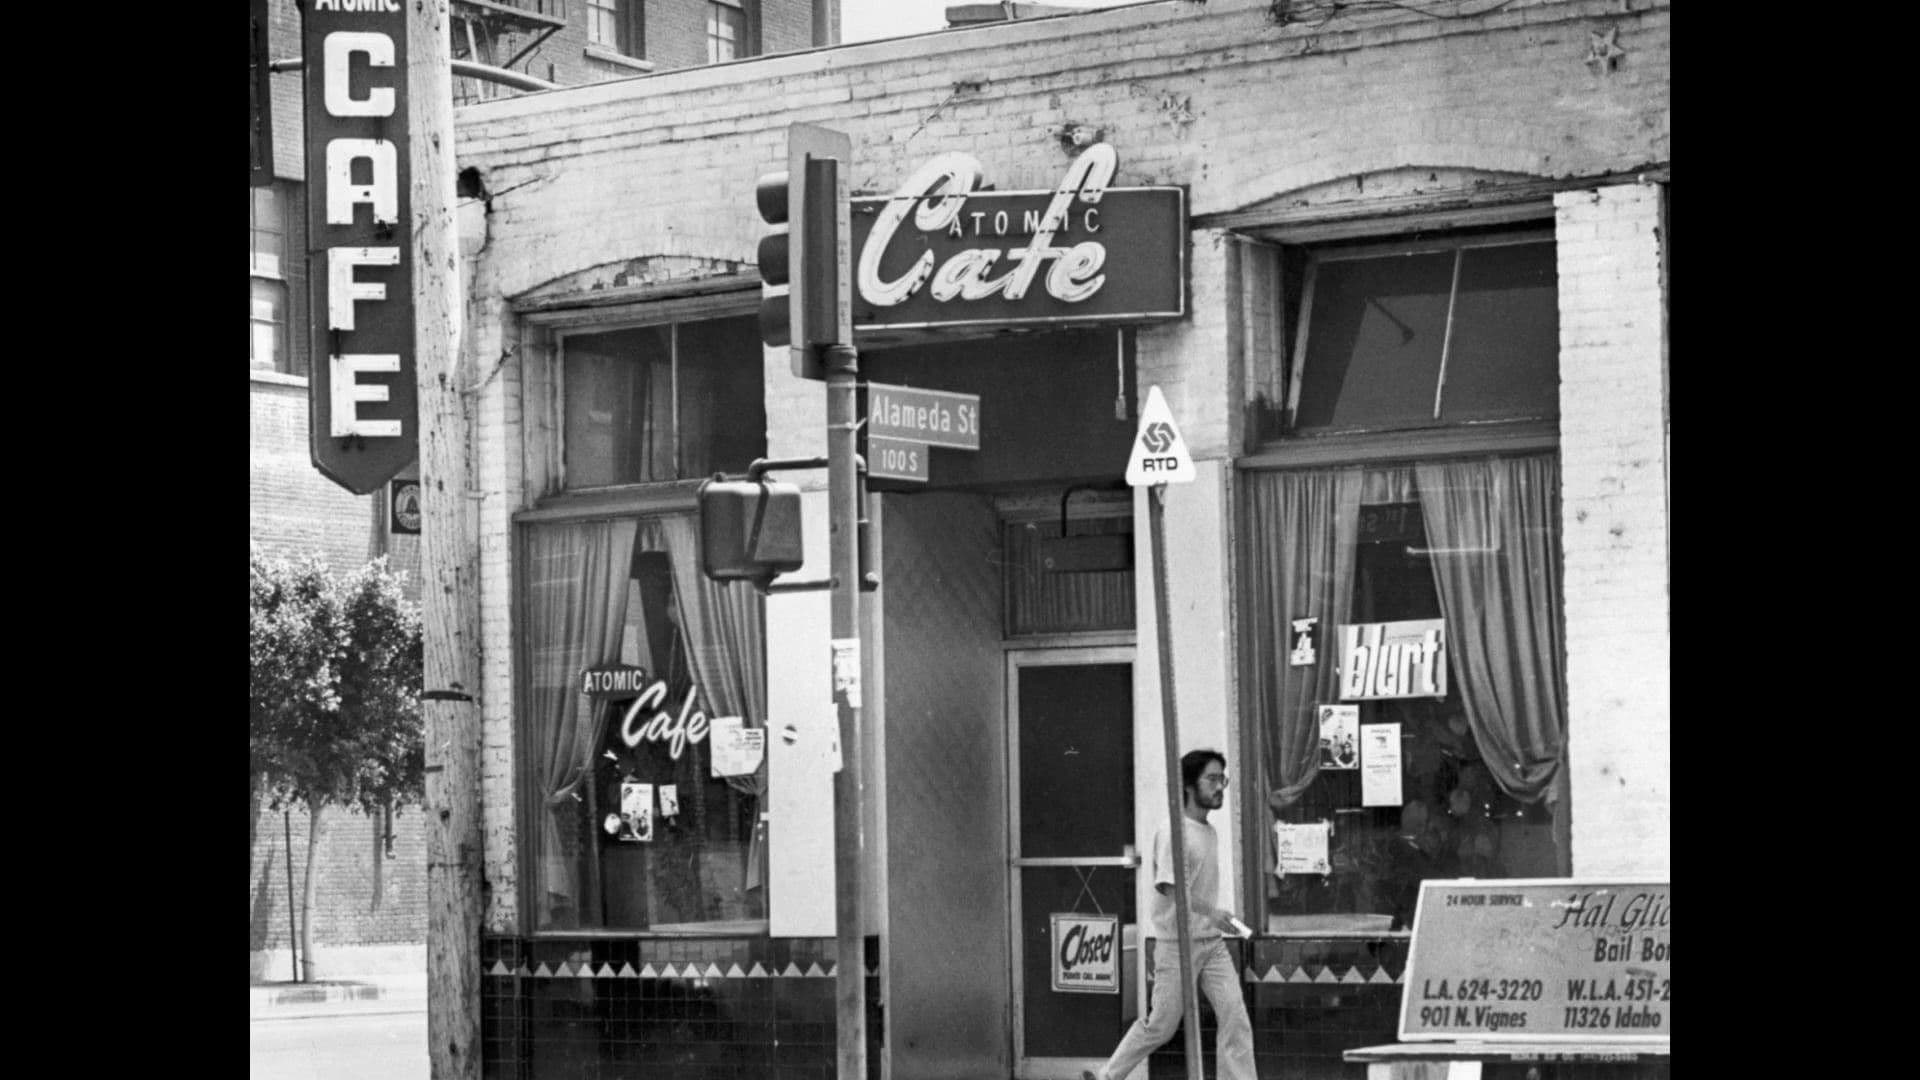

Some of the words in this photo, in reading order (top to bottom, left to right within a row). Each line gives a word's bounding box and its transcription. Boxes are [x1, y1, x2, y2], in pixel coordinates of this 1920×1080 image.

[323, 31, 402, 437] CAFE
[858, 142, 1117, 306] Cafe
[872, 394, 950, 433] Alameda
[958, 404, 977, 436] St
[1143, 456, 1178, 472] RTD
[1342, 624, 1442, 698] blurt
[583, 670, 643, 693] ATOMIC
[622, 681, 710, 760] Cafe
[1552, 893, 1617, 930] Hal
[1060, 922, 1116, 971] Closed
[1594, 935, 1633, 962] Bail
[1457, 979, 1543, 1001] 624-3220
[1567, 979, 1622, 1001] W.L.A.
[1421, 1005, 1450, 1027] 901
[1454, 1005, 1472, 1027] N.
[1474, 1005, 1527, 1032] Vignes
[1564, 1006, 1611, 1028] 11326
[1615, 1005, 1662, 1028] Idaho
